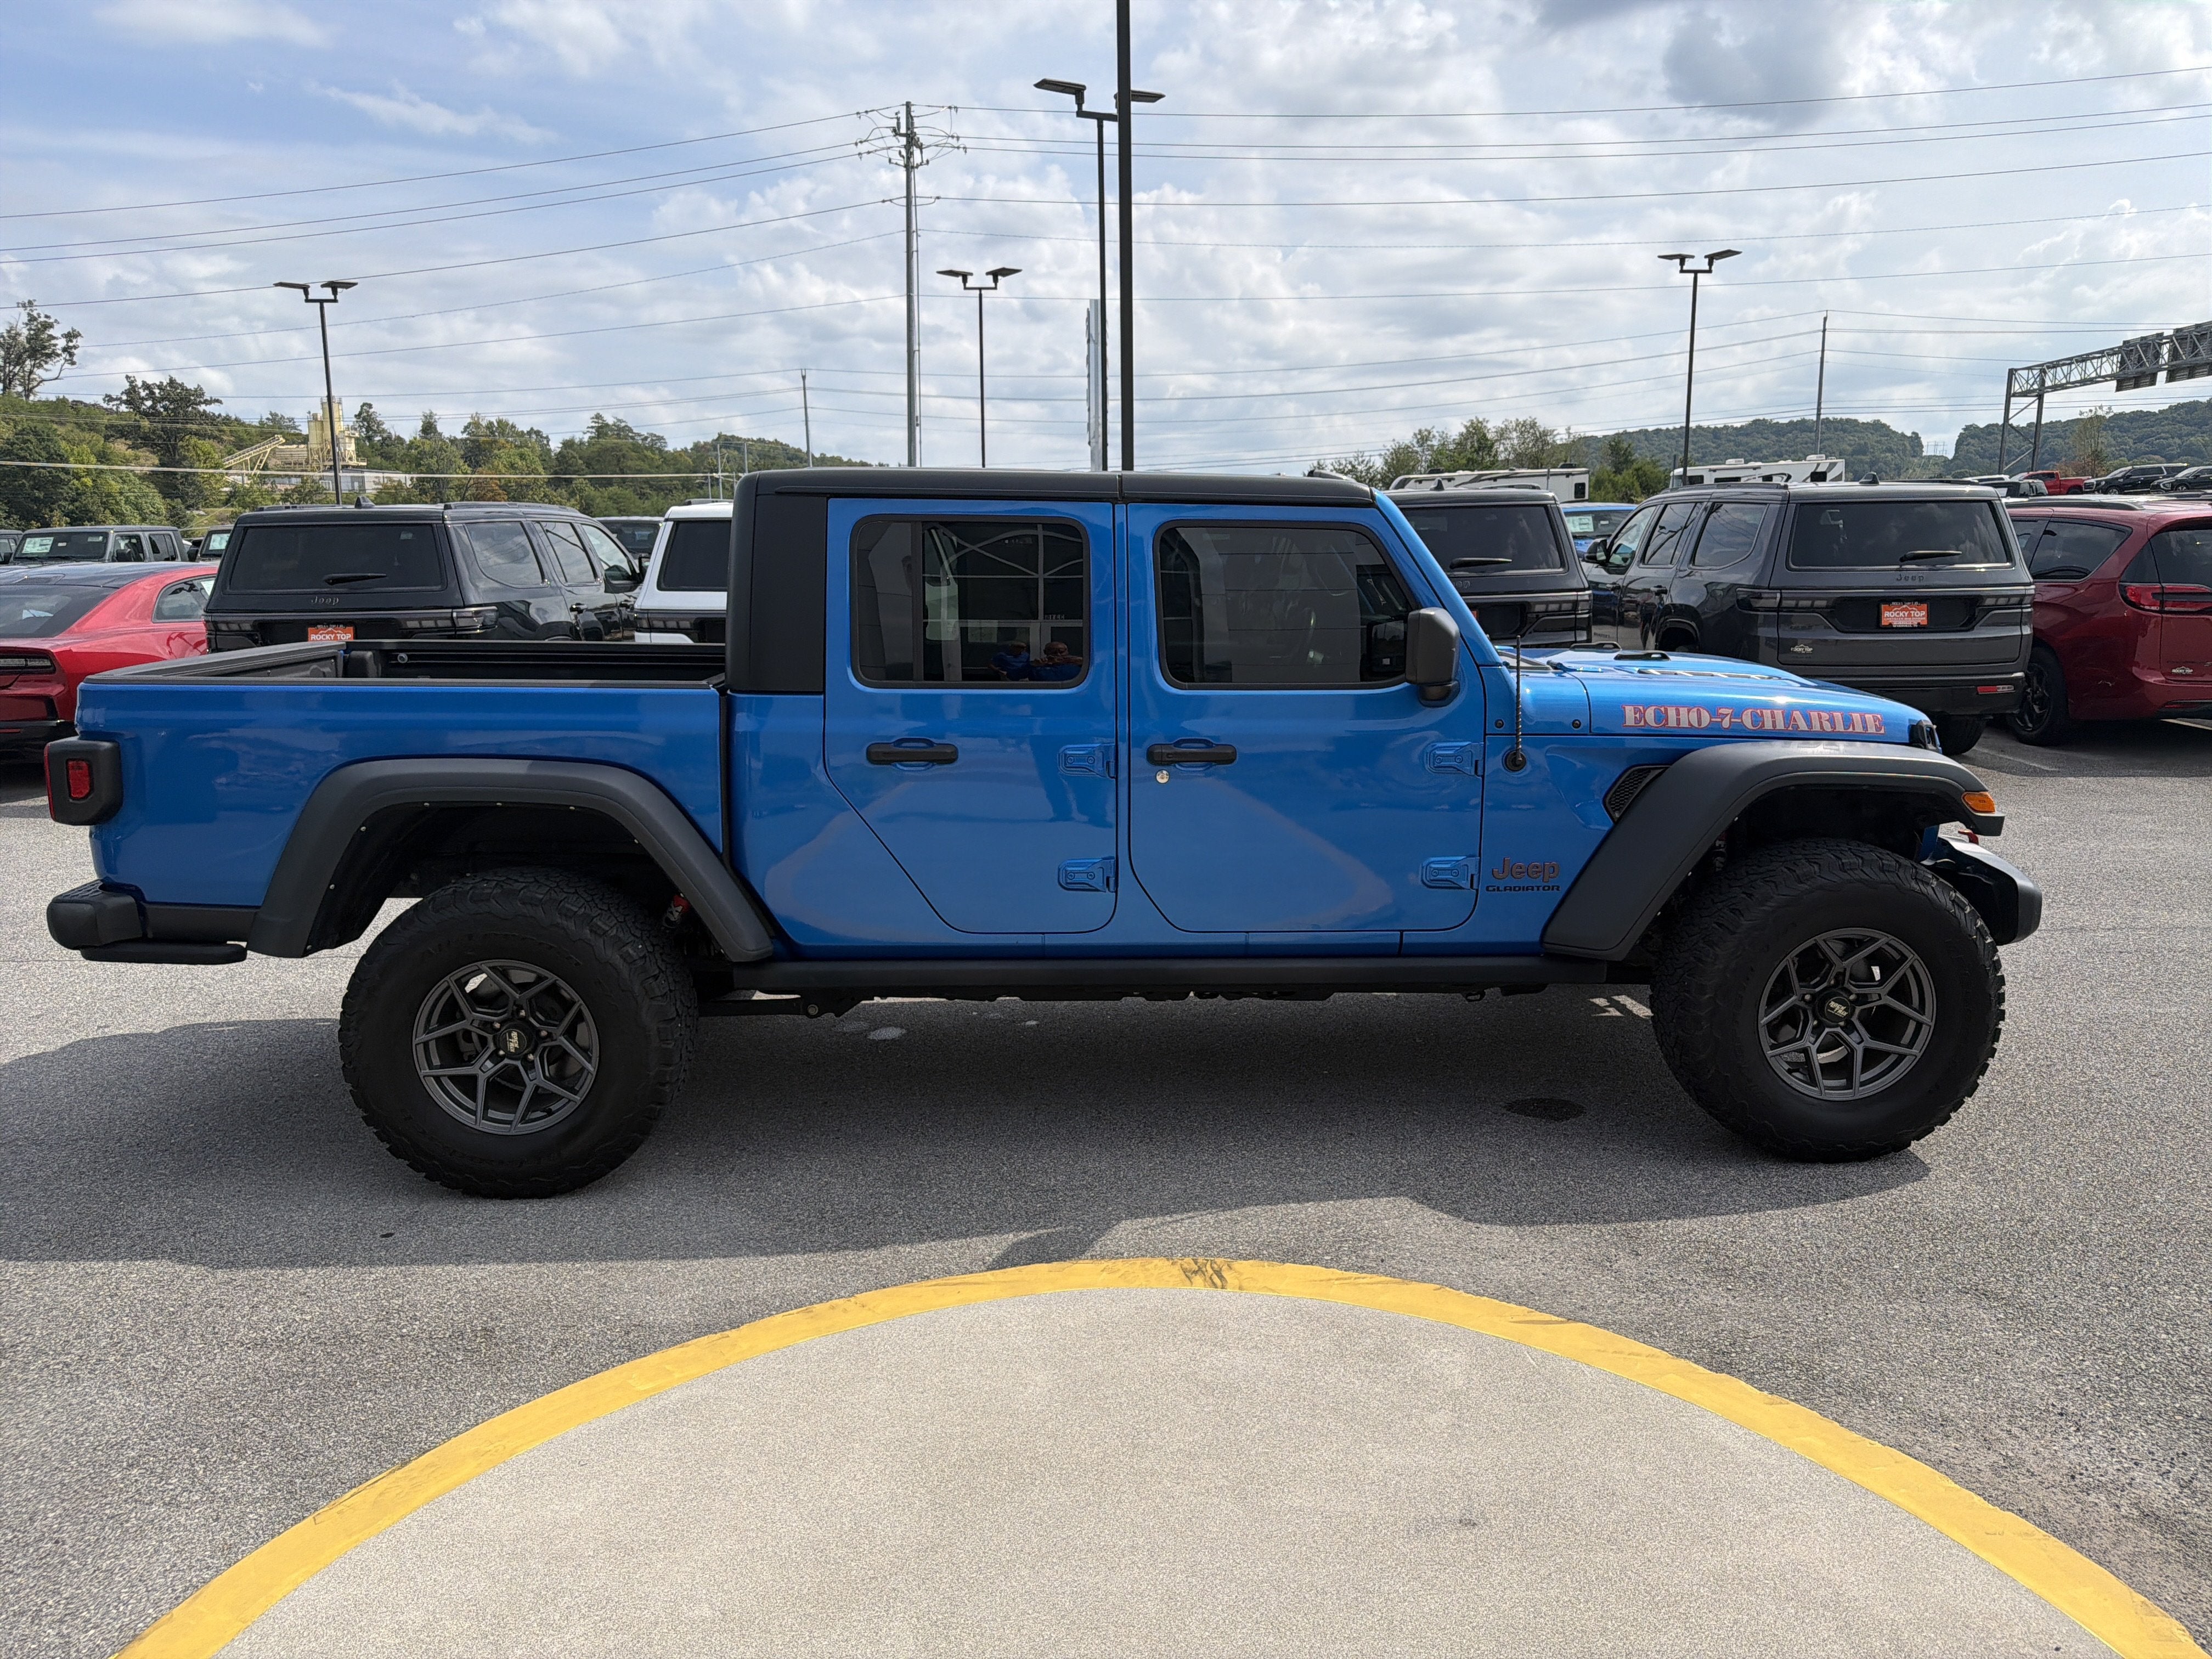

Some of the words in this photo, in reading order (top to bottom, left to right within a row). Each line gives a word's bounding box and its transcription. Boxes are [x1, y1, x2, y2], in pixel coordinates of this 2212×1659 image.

[1897, 574, 1924, 582] Jeep
[1622, 705, 1885, 734] ECHO-7-CHARLIE
[1492, 857, 1560, 883] Jeep
